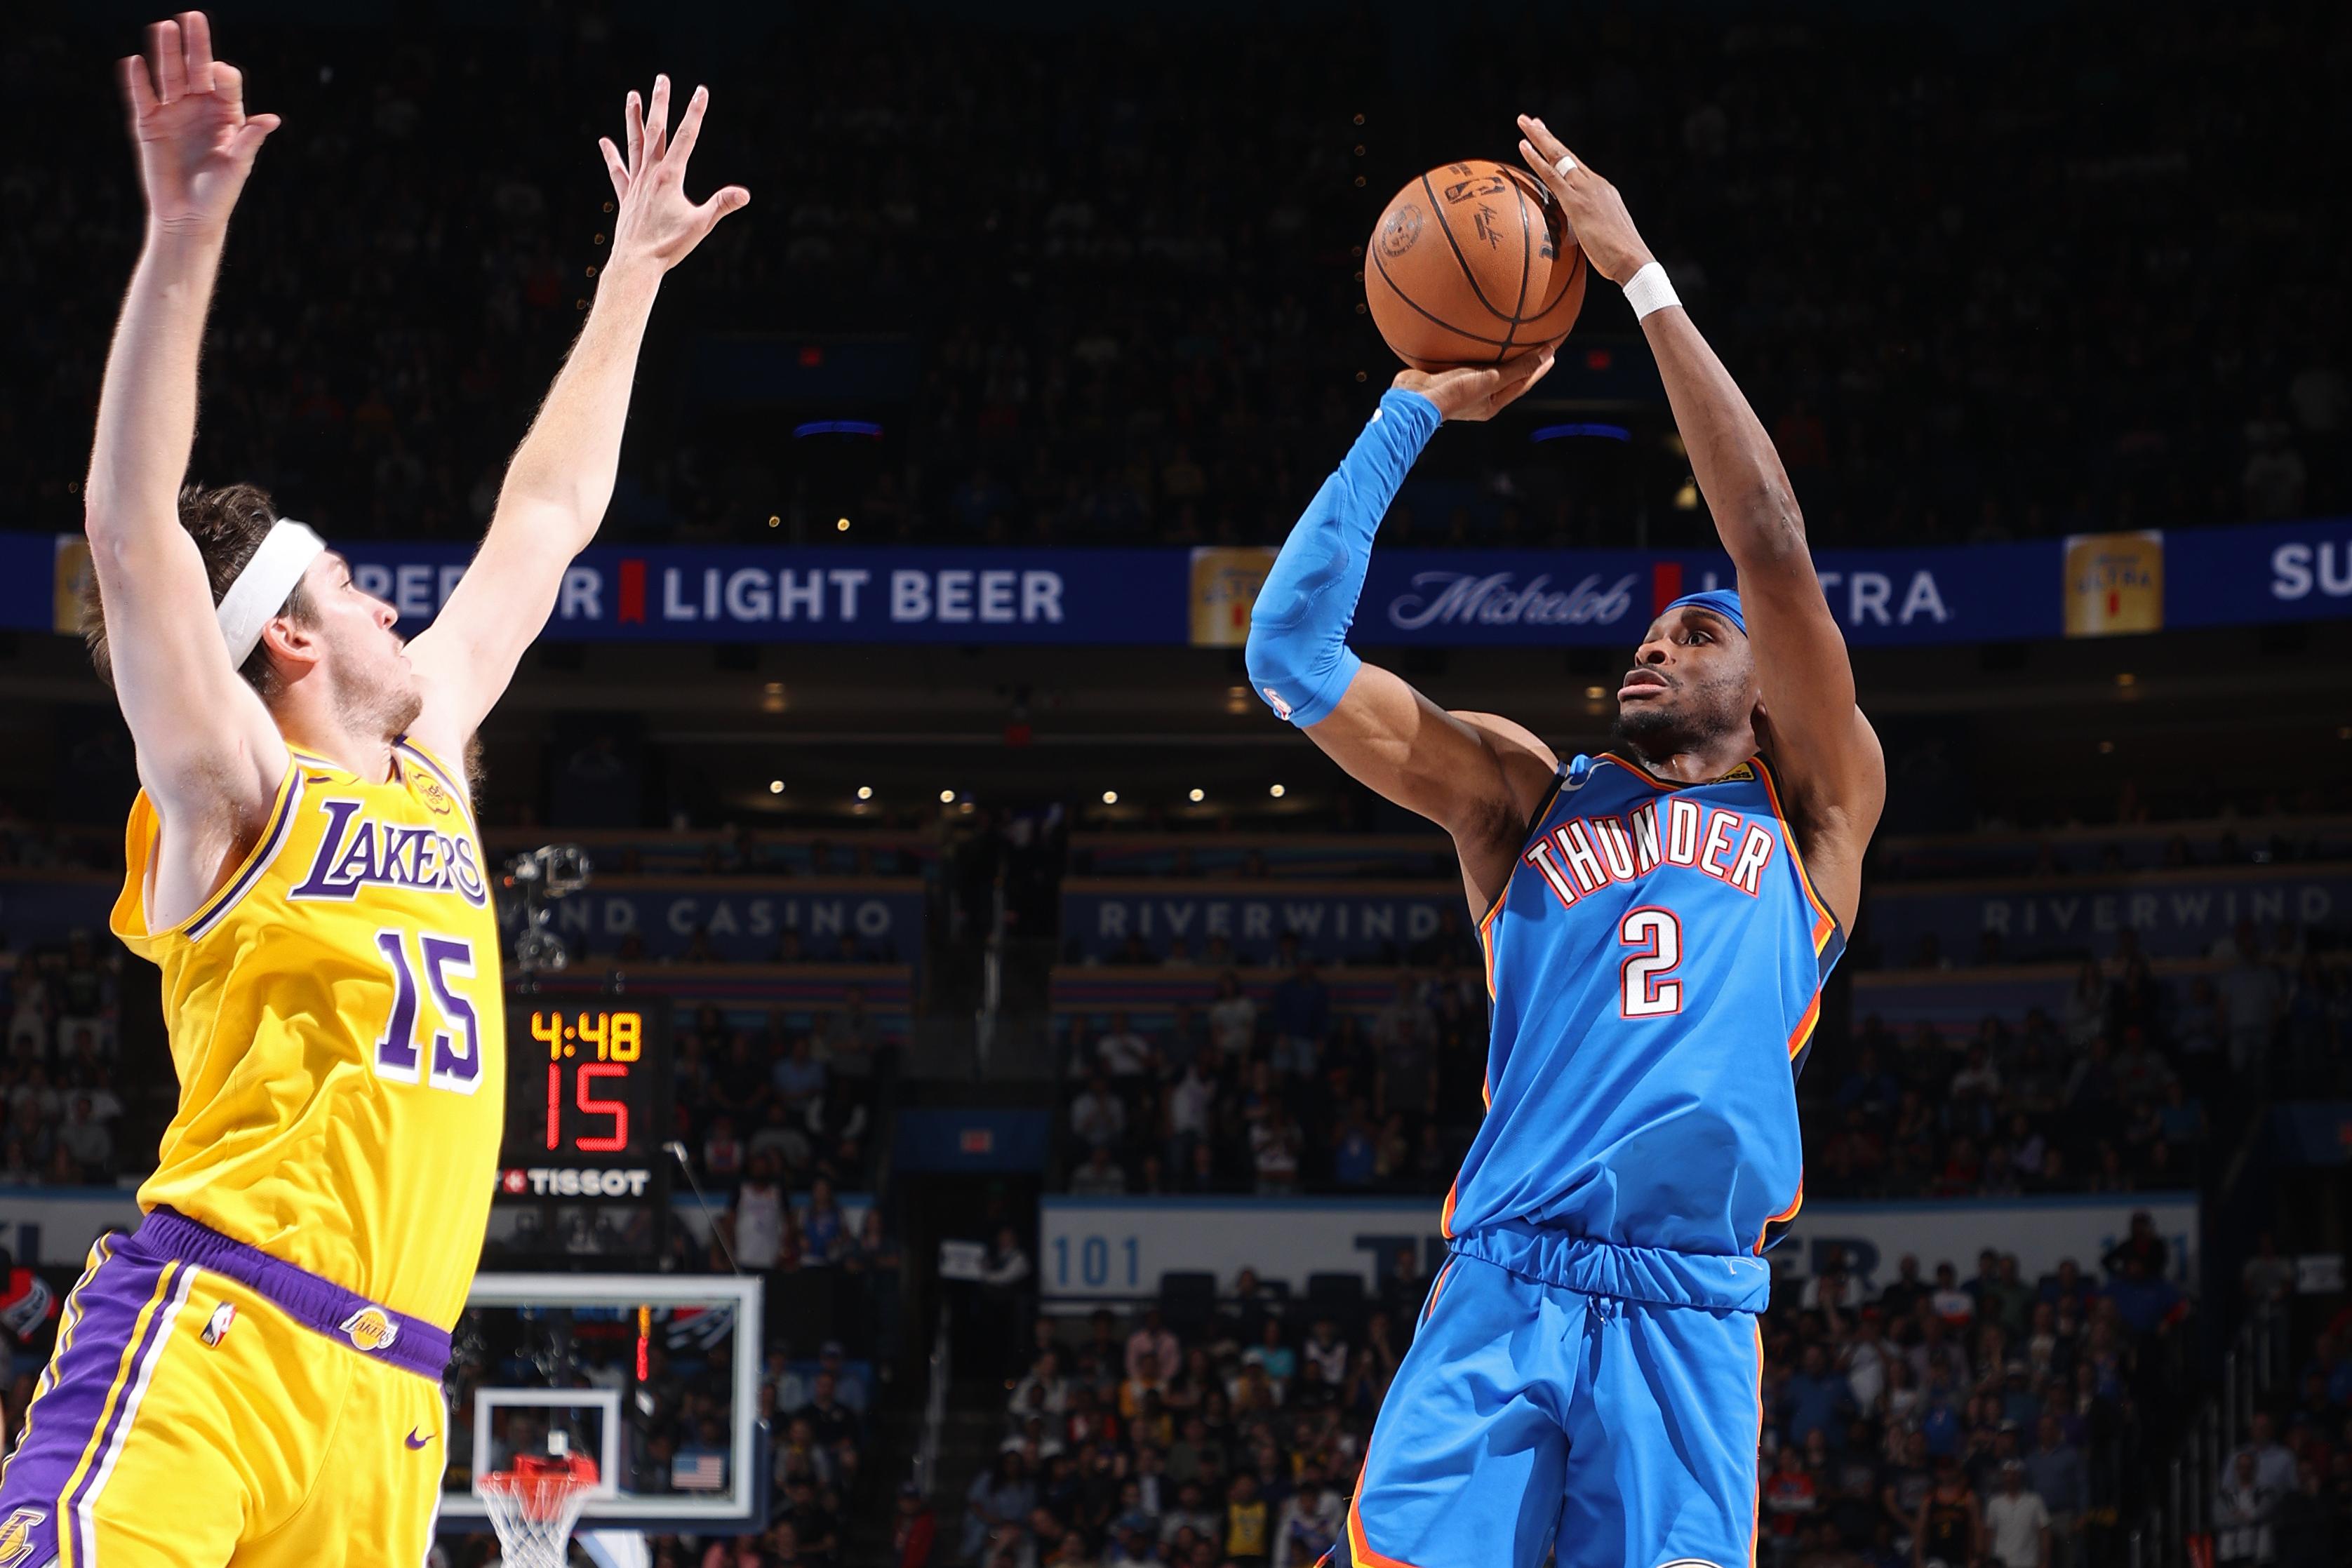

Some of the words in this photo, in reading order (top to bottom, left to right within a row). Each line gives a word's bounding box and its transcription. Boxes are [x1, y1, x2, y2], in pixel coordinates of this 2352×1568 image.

[662, 567, 869, 622] LIGHT
[889, 570, 1065, 624] BEER
[1388, 571, 1639, 630] Michelob
[286, 797, 487, 910] LAKERS
[1523, 797, 1775, 910] THUNDER
[667, 898, 893, 937] CASINO
[1098, 901, 1441, 939] RIVERWIND
[1982, 885, 2332, 935] RIVERWIND
[1619, 905, 1683, 1019] 2
[373, 927, 483, 1096] 15
[531, 1011, 641, 1061] 4:48
[547, 1063, 629, 1152] 15
[527, 1168, 650, 1196] TISSOT
[1055, 1235, 1140, 1287] 101
